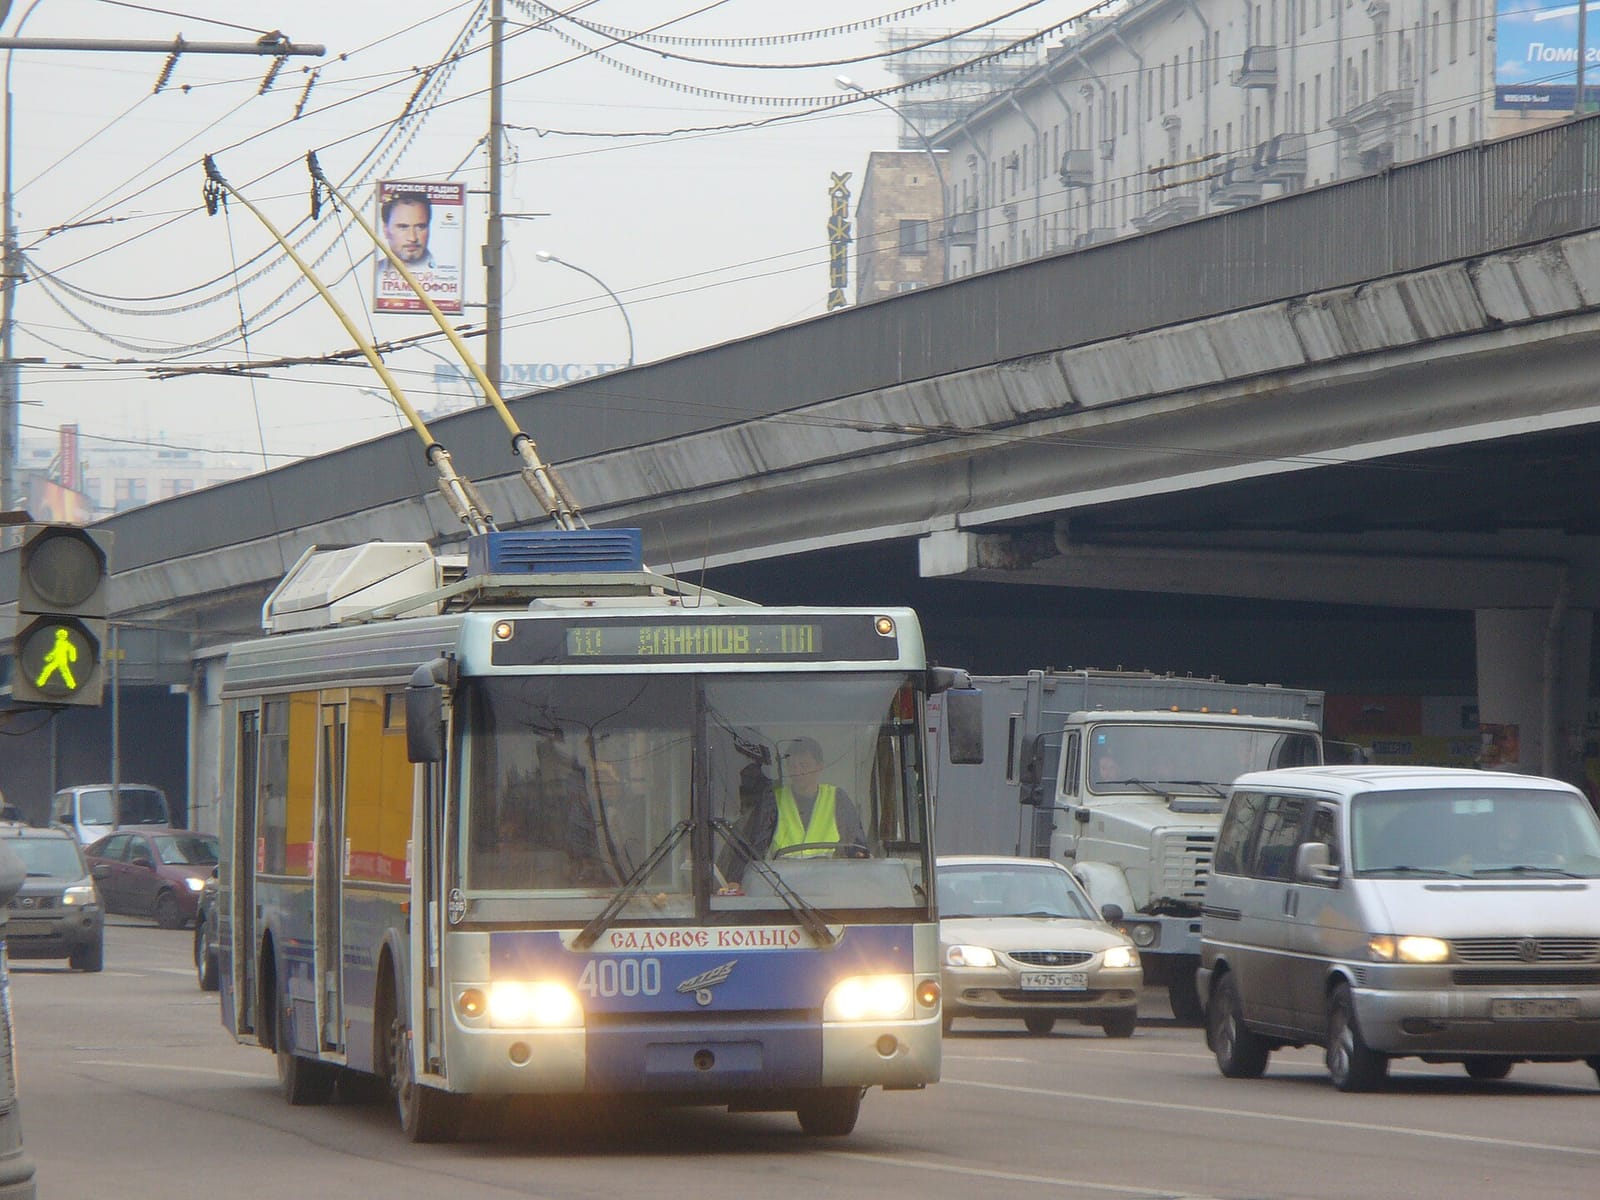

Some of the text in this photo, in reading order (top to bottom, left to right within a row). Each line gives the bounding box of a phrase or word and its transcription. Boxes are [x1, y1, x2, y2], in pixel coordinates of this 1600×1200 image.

[828, 171, 852, 311] ХИЖИНА
[382, 271, 433, 280] ЗОТОЙ
[382, 281, 458, 293] ГРАМОФОН
[610, 928, 801, 950] САДОВОЕ КОЛЬЦО
[577, 958, 661, 998] 4000
